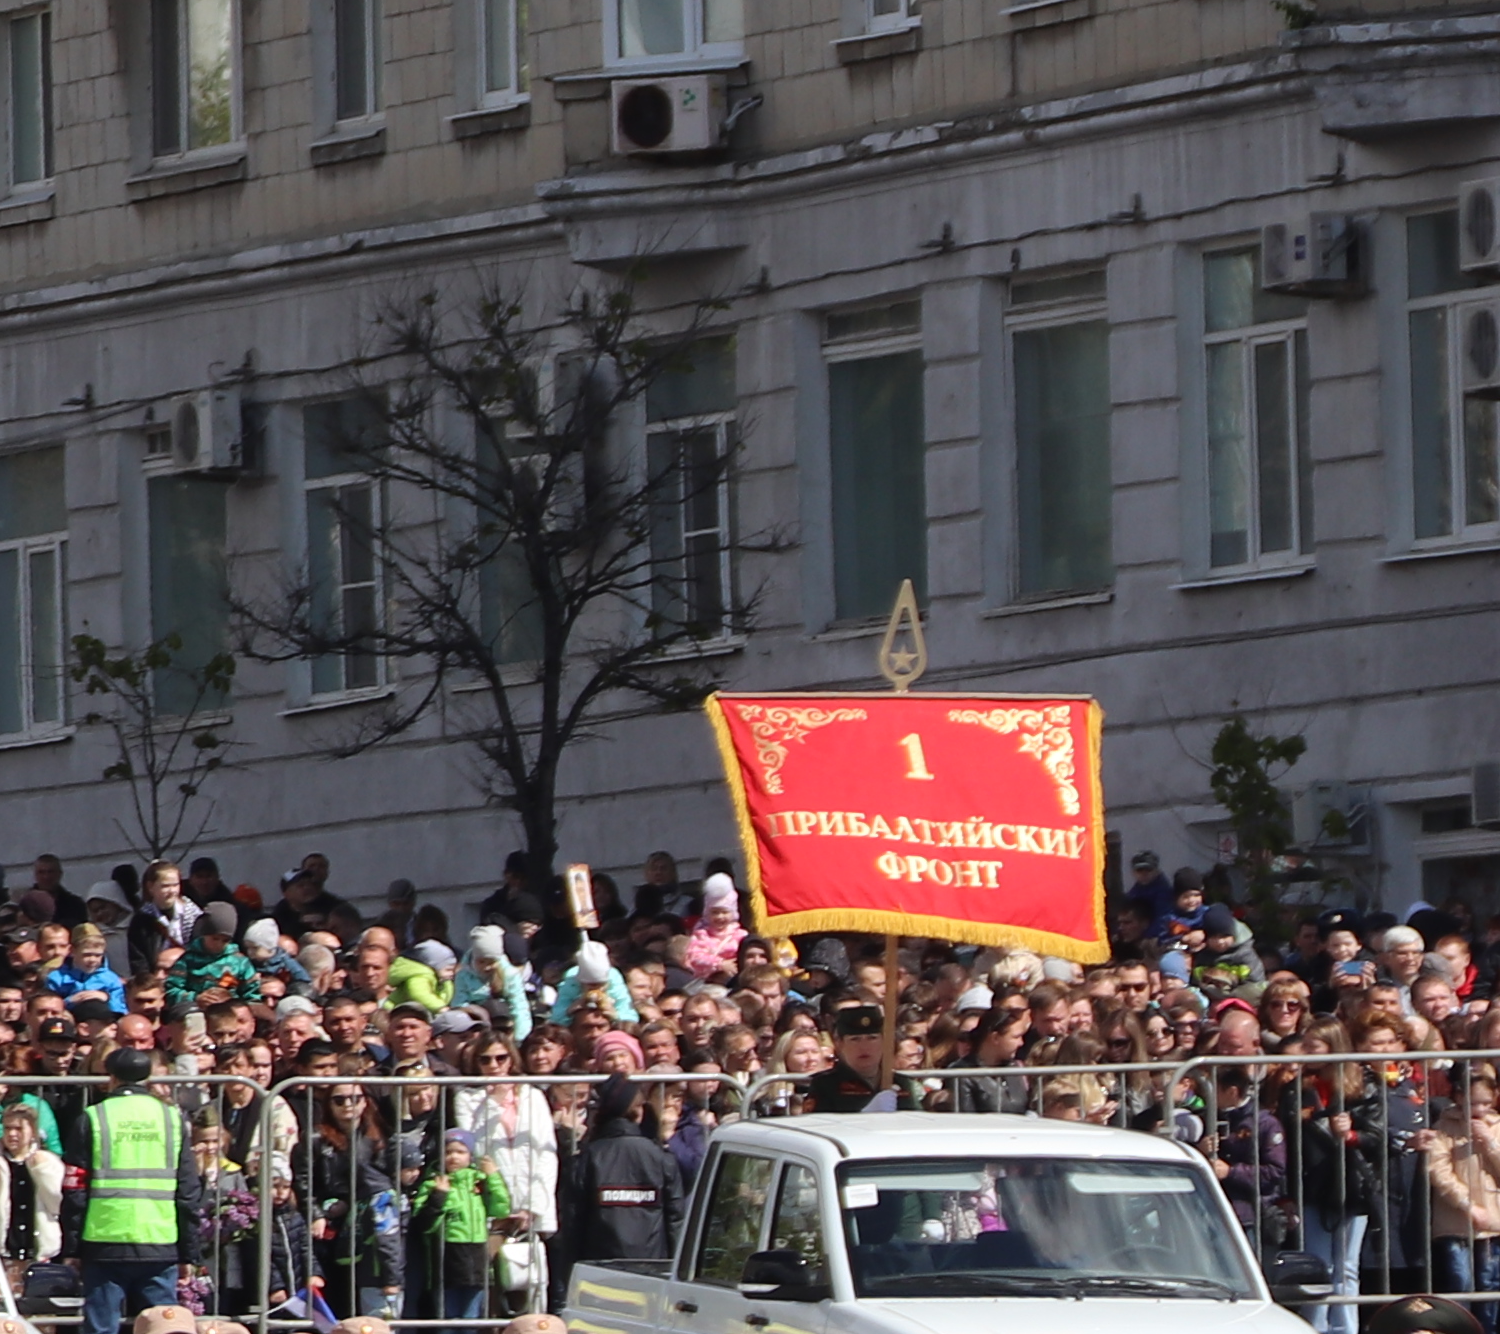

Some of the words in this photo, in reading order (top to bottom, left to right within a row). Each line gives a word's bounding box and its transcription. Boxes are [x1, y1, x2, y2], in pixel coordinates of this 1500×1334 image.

[898, 732, 935, 781] 1
[765, 810, 1086, 859] ПРИБАЛТИЙСКИЙ
[876, 851, 1003, 888] ФРОНТ
[602, 1190, 656, 1203] ПОЛИЦИЯ
